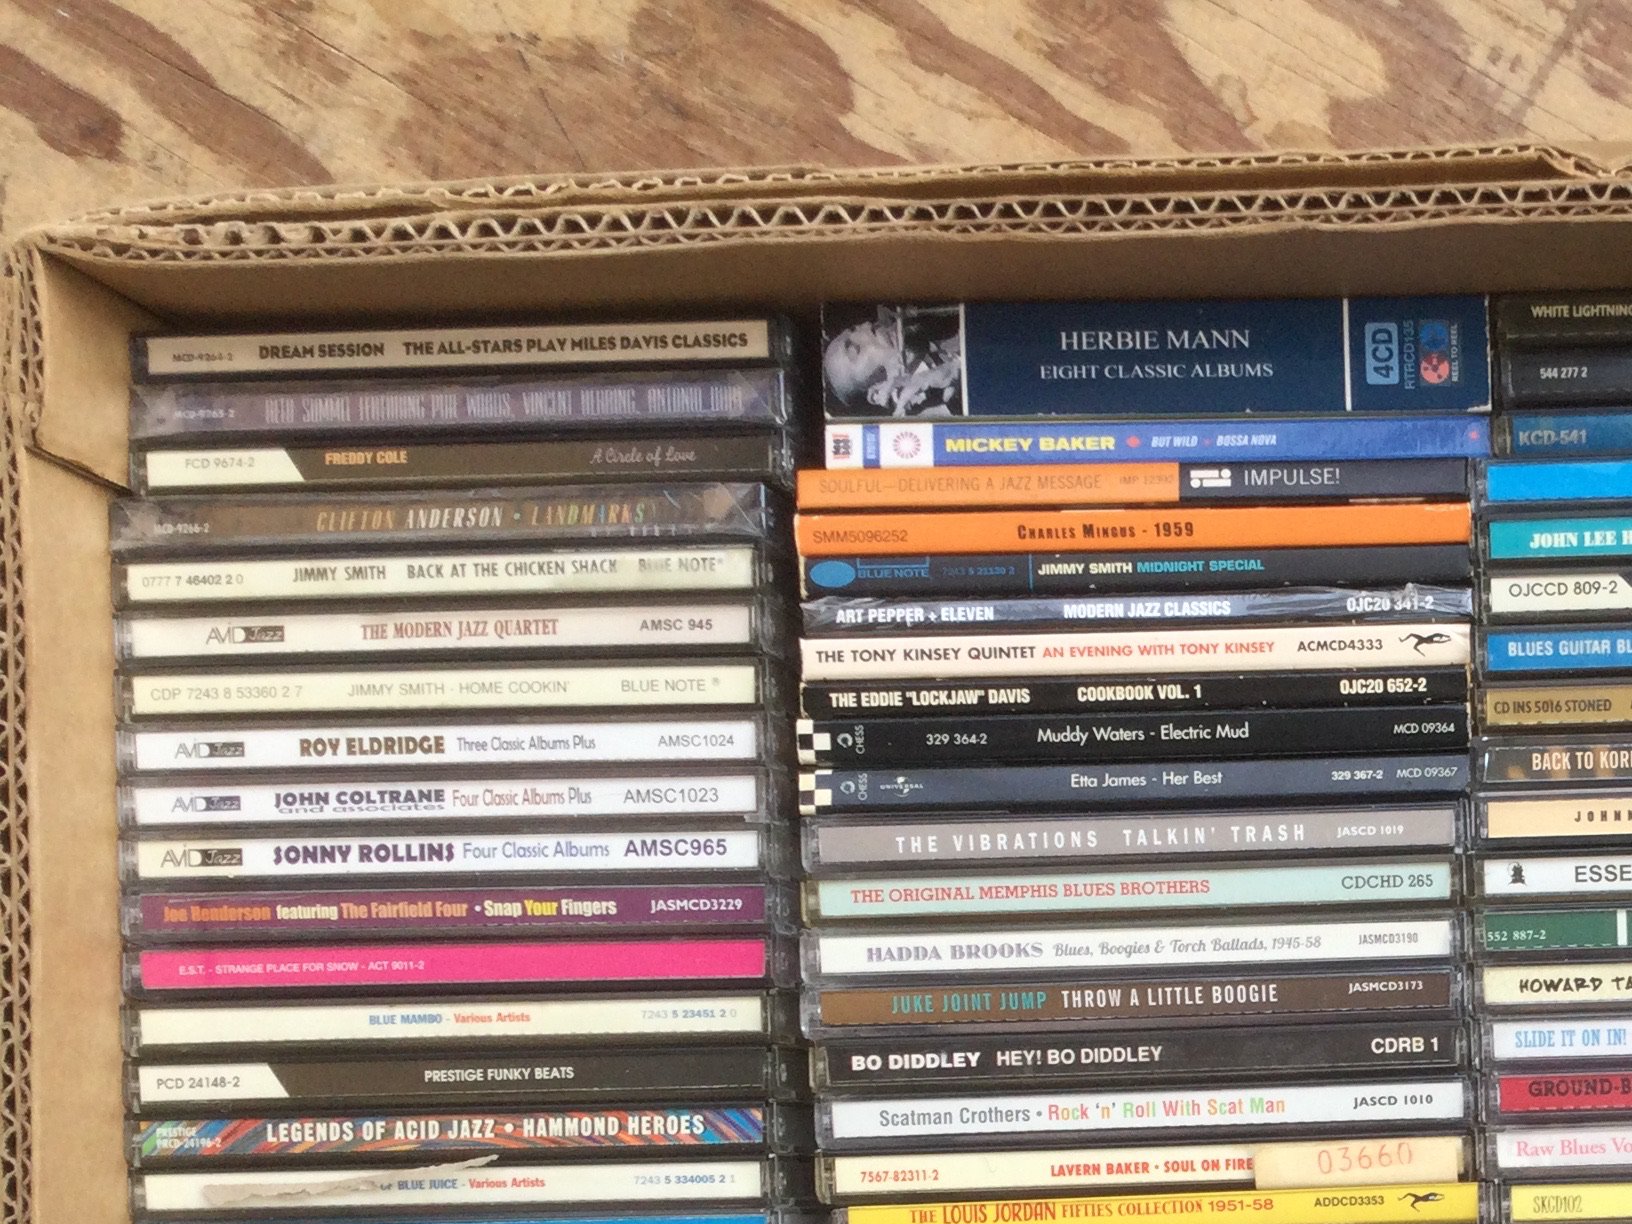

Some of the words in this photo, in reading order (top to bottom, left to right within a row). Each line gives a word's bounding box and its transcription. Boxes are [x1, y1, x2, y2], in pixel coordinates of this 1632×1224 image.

[259, 345, 314, 359] DREAM
[318, 343, 384, 358] SESSION
[403, 342, 433, 355] THE
[438, 339, 523, 354] ALL-STARS
[527, 338, 567, 352] PLAY
[571, 336, 616, 351] MILES
[620, 335, 668, 349] DAVIS
[672, 333, 747, 348] CLASSICS
[1061, 331, 1159, 350] HERBIE
[1167, 330, 1249, 349] MANN
[1372, 326, 1394, 380] 4CD
[1041, 365, 1096, 379] EIGHT
[1104, 364, 1183, 378] CLASSIC
[1191, 363, 1273, 377] ALBUMS
[946, 438, 1033, 452] MICKEY
[1039, 436, 1115, 451] BAKER
[1245, 468, 1339, 485] IMPULSE!
[1530, 532, 1578, 548] JOHN
[1584, 530, 1616, 546] LEE
[1038, 563, 1084, 575] JIMMY
[1089, 562, 1132, 574] SMITH
[1137, 561, 1204, 573] MIDNIGHT
[1209, 560, 1264, 571] SPECIAL
[1297, 639, 1383, 652] ACMCD4333
[658, 734, 734, 747] AMSC1024
[1037, 725, 1088, 746] Muddy
[1093, 727, 1144, 741] Waters
[1161, 723, 1211, 740] Electric
[1216, 721, 1249, 738] Mud
[300, 738, 340, 757] ROY
[346, 736, 445, 755] ELDRIDGE
[274, 845, 351, 865] SONNY
[359, 843, 454, 862] ROLLINS
[463, 842, 497, 859] Four
[502, 841, 548, 858] Classic
[553, 841, 609, 857] Albums
[624, 839, 727, 856] AMSC965
[1519, 977, 1603, 993] HOWARD
[1371, 1037, 1424, 1053] CDRB
[1431, 1037, 1438, 1051] 1
[852, 1055, 882, 1070] BO
[889, 1052, 980, 1069] DIDDLEY
[997, 1050, 1041, 1066] HEY!
[1047, 1049, 1075, 1064] BO
[1081, 1046, 1162, 1063] DIDDLEY
